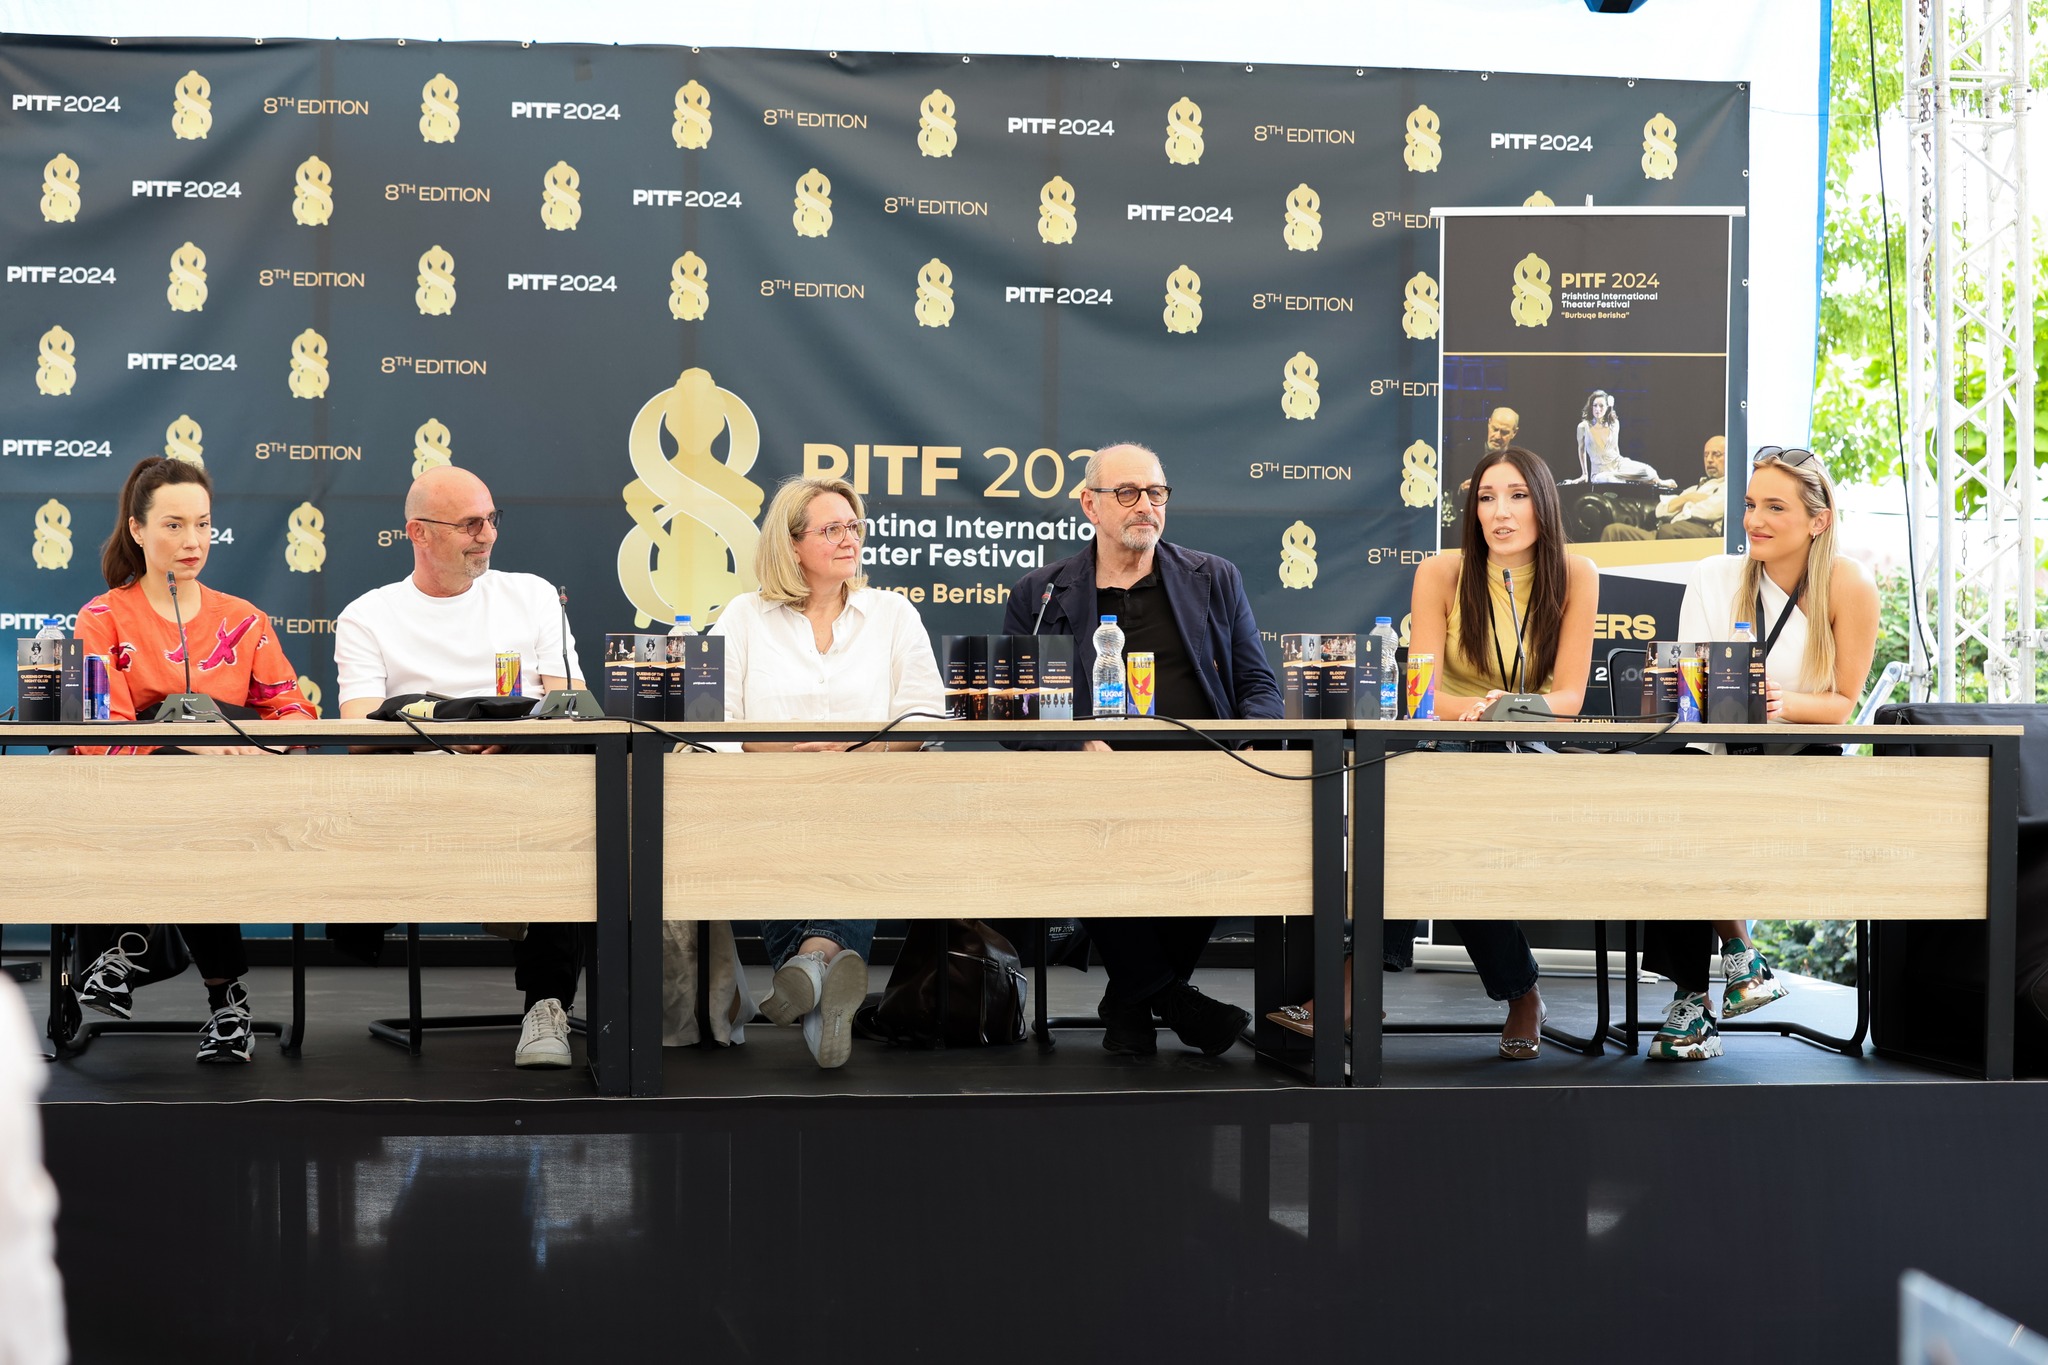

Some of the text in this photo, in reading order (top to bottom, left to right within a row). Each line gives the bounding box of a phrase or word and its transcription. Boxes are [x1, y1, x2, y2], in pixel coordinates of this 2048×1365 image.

[12, 94, 122, 113] PITF 2024
[263, 96, 369, 115] 8TH EDITION
[511, 101, 621, 121] PITF 2024
[763, 108, 867, 129] 8TH EDITION
[1007, 117, 1115, 136] PITF 2024
[1254, 124, 1355, 144] 8TH EDITION
[1490, 132, 1594, 152] PITF 2024
[131, 180, 242, 199] PITF 2024
[384, 183, 491, 203] 8TH EDITION
[632, 189, 743, 209] PITF 2024
[884, 196, 988, 216] 8TH EDITION
[1127, 204, 1234, 223] PITF 2024
[1372, 211, 1401, 228] 8TH
[6, 265, 117, 284] PITF 2024
[259, 268, 365, 288] 8TH EDITION
[507, 273, 618, 292] PITF 2024
[1561, 272, 1660, 289] PITF 2024
[760, 279, 865, 299] 8TH EDITION
[1005, 286, 1114, 305] PITF 2024
[1561, 292, 1658, 300] Prishtina International
[1252, 292, 1353, 312] 8TH EDITION
[127, 352, 238, 371] PITF 2024
[381, 356, 487, 375] 8TH EDITION
[1369, 379, 1439, 397] 8TH EDIT
[2, 439, 113, 458] PITF 2024
[255, 442, 362, 461] 8TH EDITION
[803, 443, 1097, 499] PITF 202
[1249, 462, 1351, 481] 8TH EDITION
[946, 515, 1096, 541] Internatio
[861, 543, 1044, 568] ater Festival
[1367, 547, 1398, 565] 8TH
[933, 583, 1011, 605] Berish
[286, 618, 339, 634] EDITIO
[1594, 614, 1657, 640] ERS
